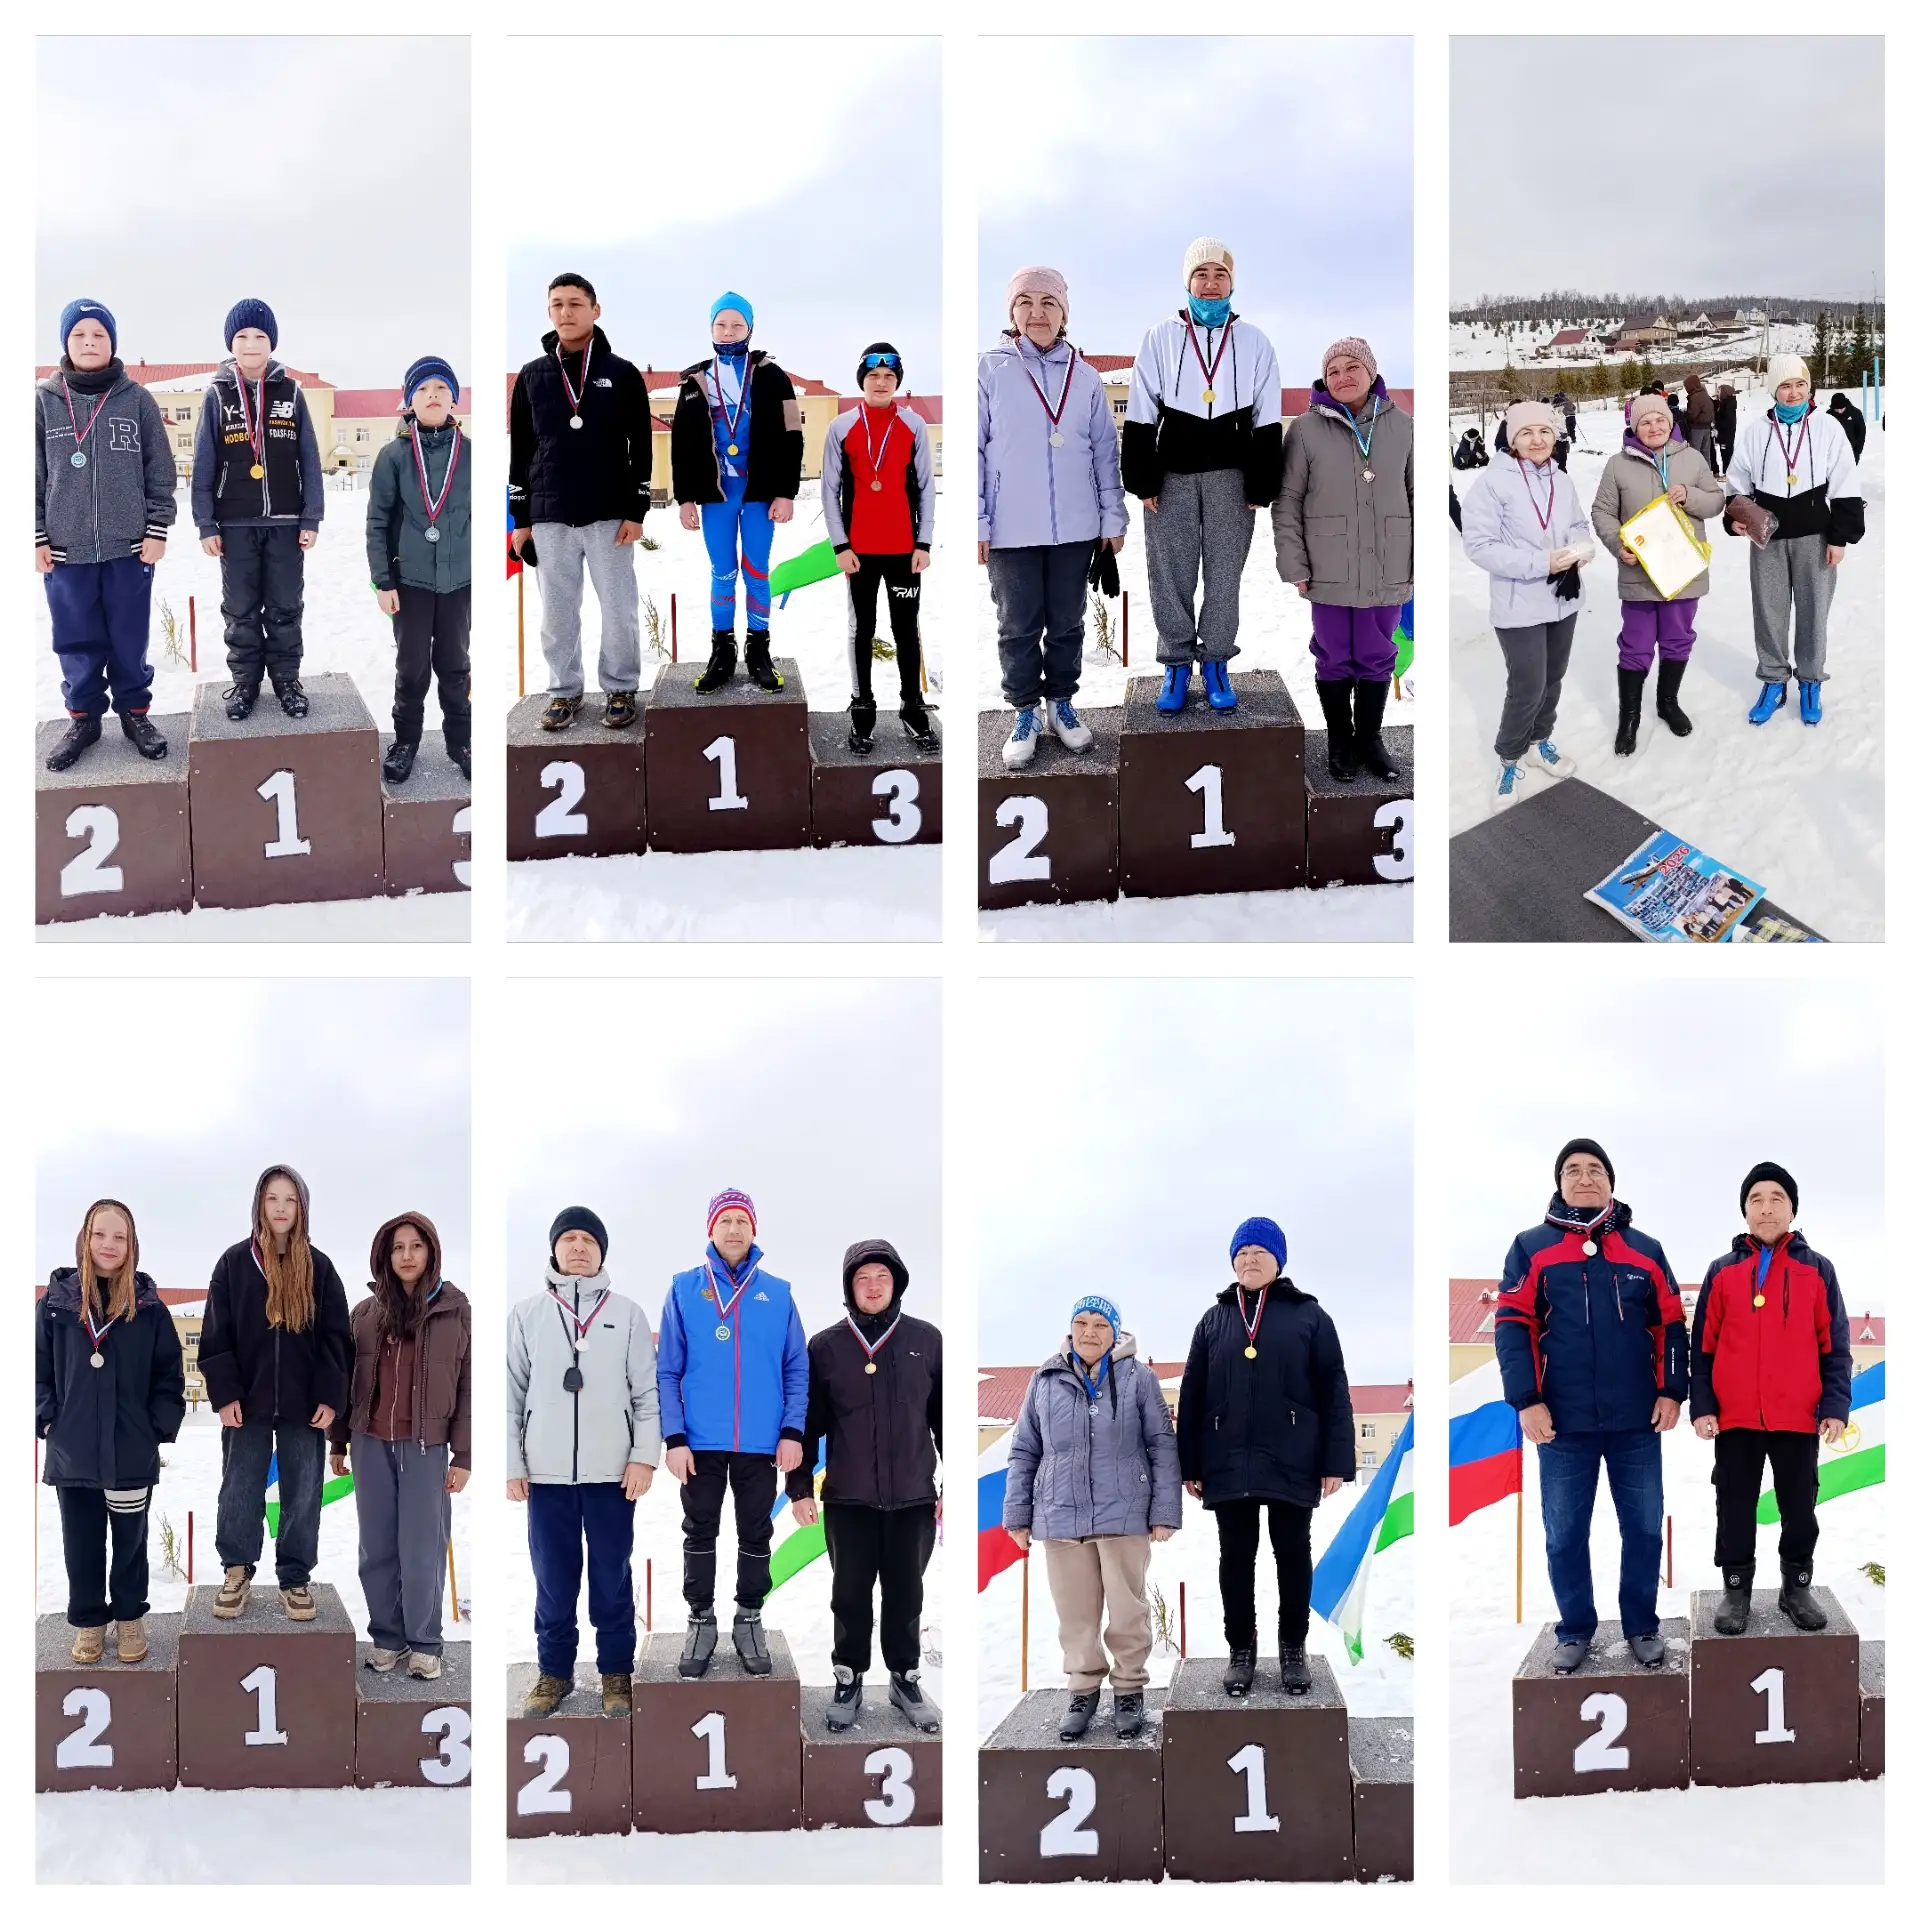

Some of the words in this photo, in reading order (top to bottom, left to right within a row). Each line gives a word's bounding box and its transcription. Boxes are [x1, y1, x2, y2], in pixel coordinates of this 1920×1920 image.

[109, 417, 140, 452] R
[536, 761, 587, 837] 2
[703, 736, 748, 810] 1
[872, 770, 921, 842] 3
[1185, 765, 1235, 848] 1
[60, 805, 124, 897] 2
[257, 771, 311, 857] 1
[990, 796, 1049, 884] 2
[1373, 799, 1414, 880] 3
[1660, 846, 1690, 876] 2026
[57, 1689, 112, 1768] 2
[240, 1666, 288, 1745] 1
[1575, 1694, 1629, 1772] 2
[1751, 1668, 1796, 1743] 1
[420, 1706, 471, 1784] 3
[517, 1735, 571, 1814] 2
[691, 1712, 737, 1789] 1
[864, 1748, 914, 1825] 3
[1040, 1768, 1099, 1857] 2
[1228, 1745, 1280, 1832] 1
